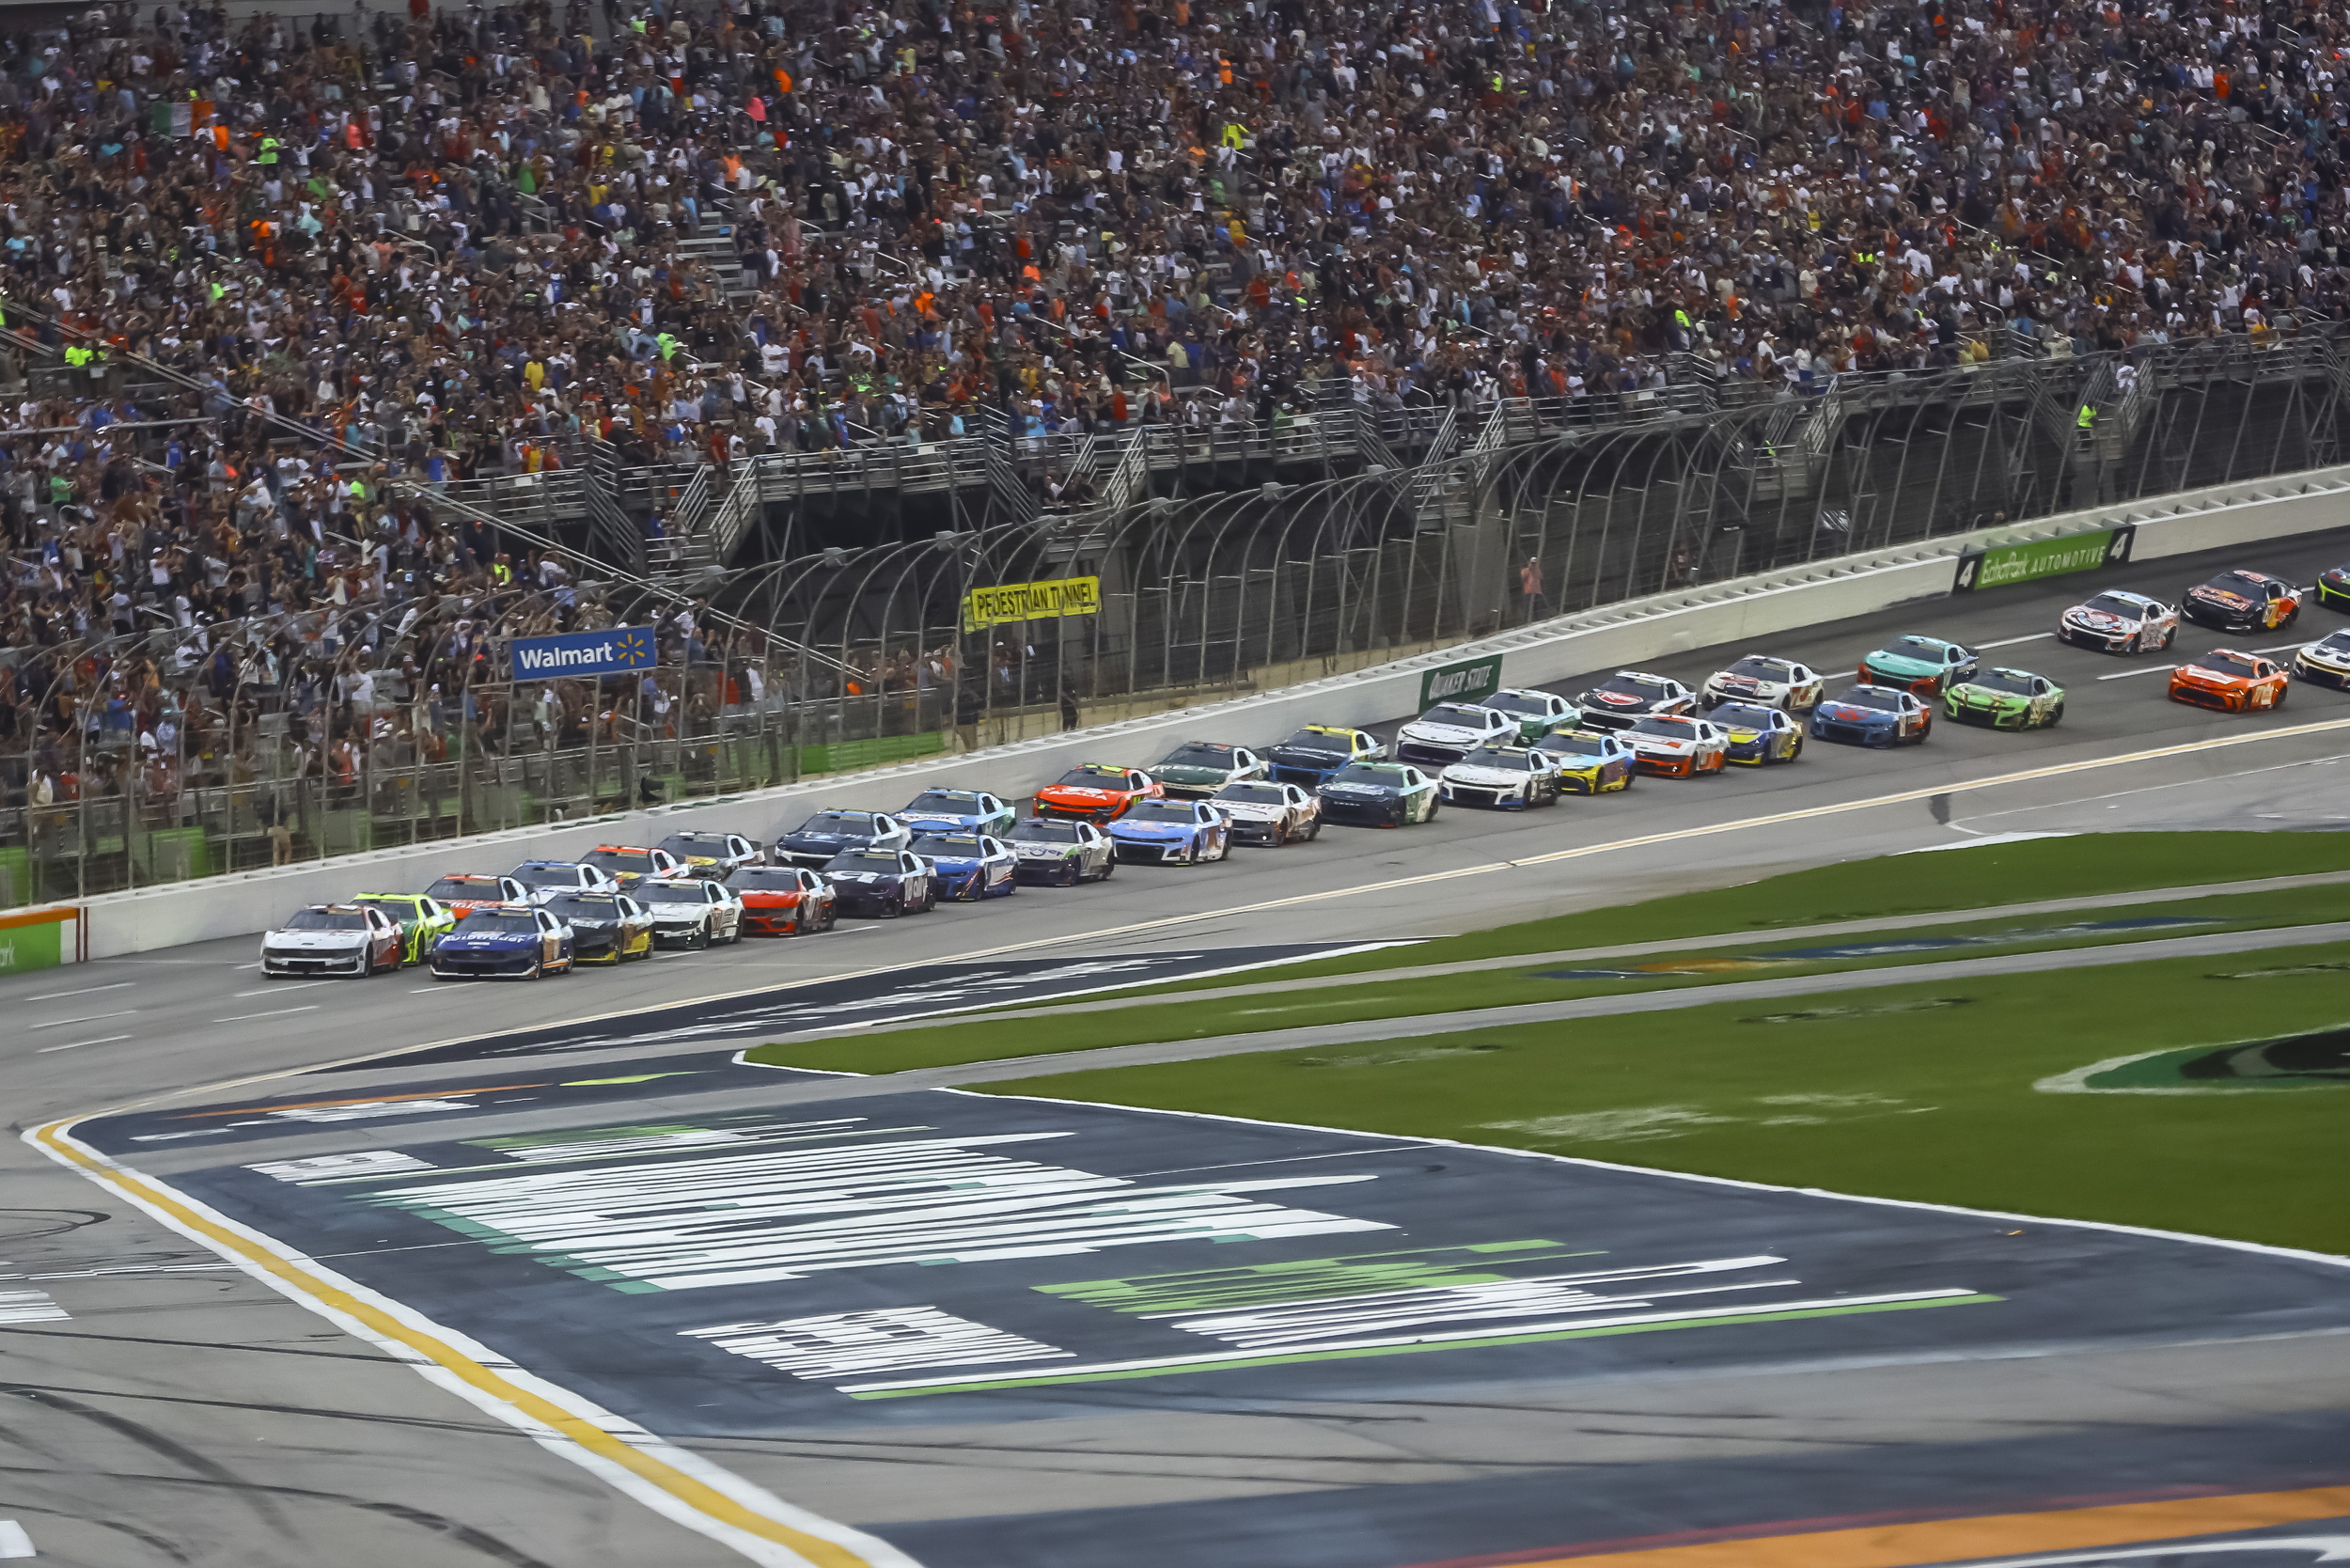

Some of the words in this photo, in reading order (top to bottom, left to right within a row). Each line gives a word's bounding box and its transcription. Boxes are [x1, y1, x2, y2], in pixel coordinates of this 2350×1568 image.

[2030, 546, 2106, 573] AUTOMOTIVE
[977, 586, 1049, 618] PEDESTRIAN
[519, 641, 613, 669] Walmart
[1428, 671, 1466, 700] QUAKER
[1465, 665, 1494, 692] STATE
